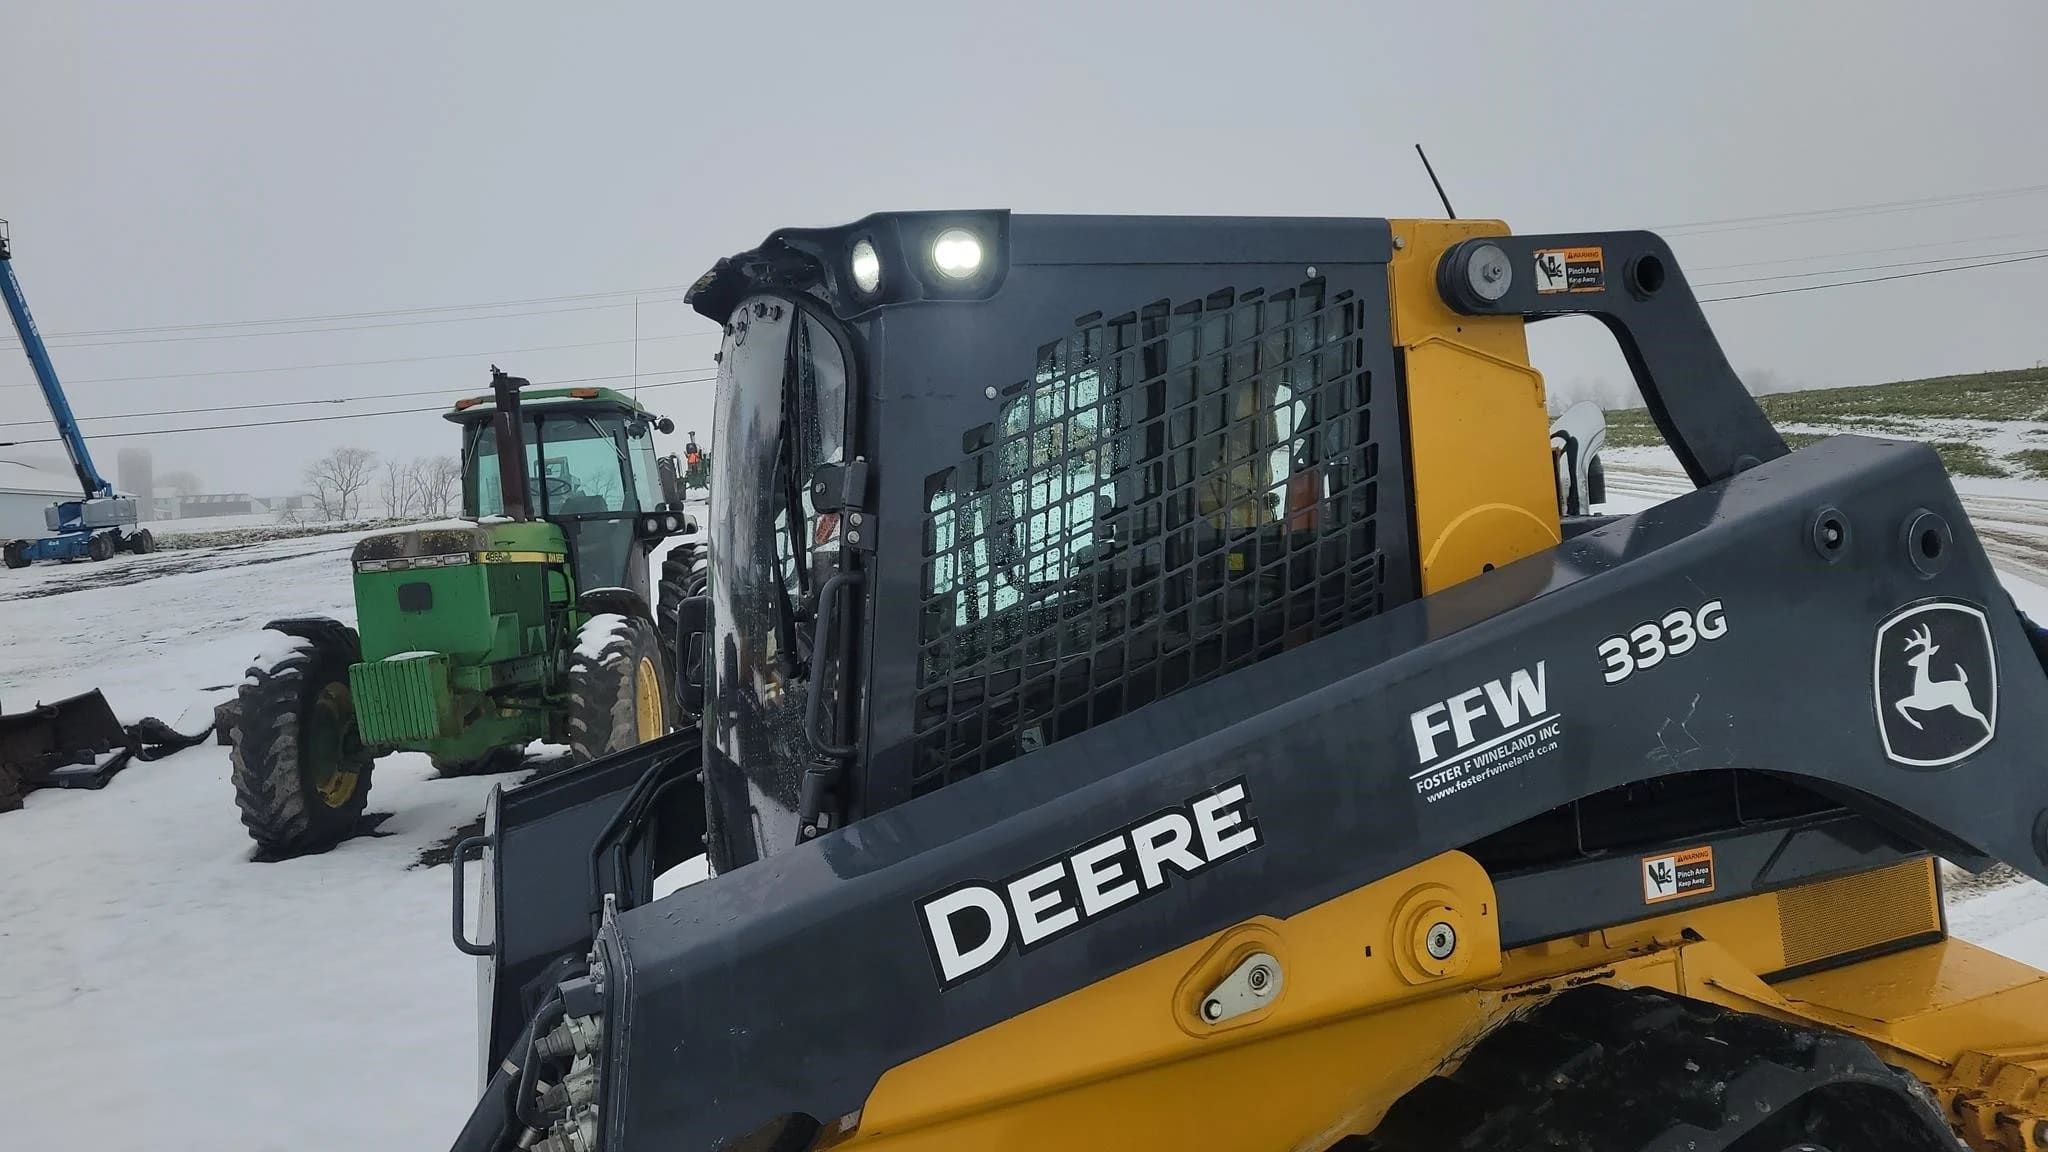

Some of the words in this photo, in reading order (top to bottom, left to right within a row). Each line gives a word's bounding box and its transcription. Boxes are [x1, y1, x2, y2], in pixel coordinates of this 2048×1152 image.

[1568, 266, 1585, 275] Pinch
[1586, 266, 1600, 274] Area
[1597, 600, 1728, 683] 333G
[1410, 659, 1547, 764] FFW
[1416, 765, 1463, 794] FOSTER
[1463, 760, 1472, 773] F
[1473, 733, 1537, 769] WINELAND
[1539, 723, 1561, 741] INC
[1427, 741, 1558, 803] www.fosterfwinelandcom
[924, 784, 1257, 982] DEERE
[1677, 869, 1694, 879] Pinch
[1695, 867, 1709, 877] Area
[1678, 879, 1691, 888] Keep
[1692, 877, 1705, 886] Away
[1682, 850, 1709, 861] WARNING
